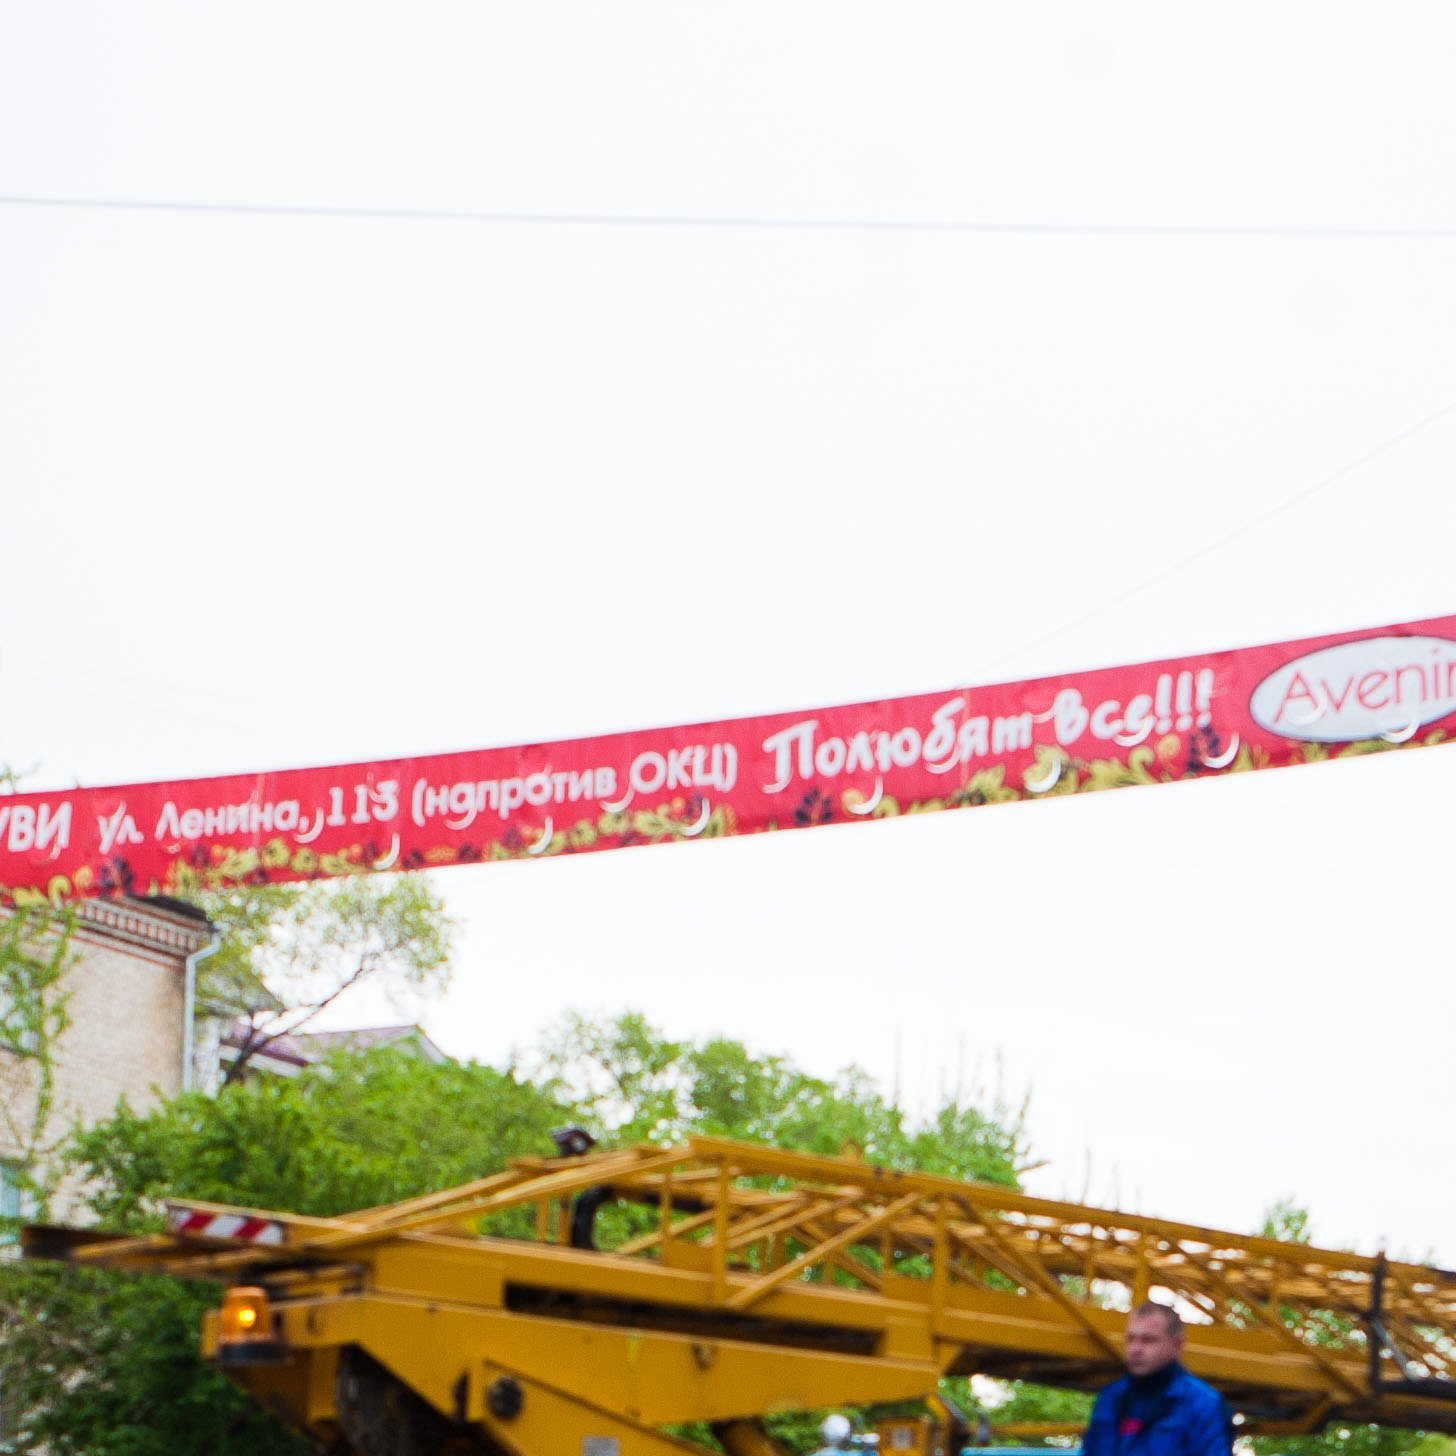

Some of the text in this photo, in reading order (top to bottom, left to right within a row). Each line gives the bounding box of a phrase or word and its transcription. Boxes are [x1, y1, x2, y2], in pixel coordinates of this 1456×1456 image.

[762, 697, 1034, 781] Полюбят
[97, 801, 144, 855] ул.
[155, 799, 310, 842] Ленина,
[327, 779, 400, 827] 113
[411, 766, 618, 828] (напротив
[629, 741, 739, 795] ОКЦ)
